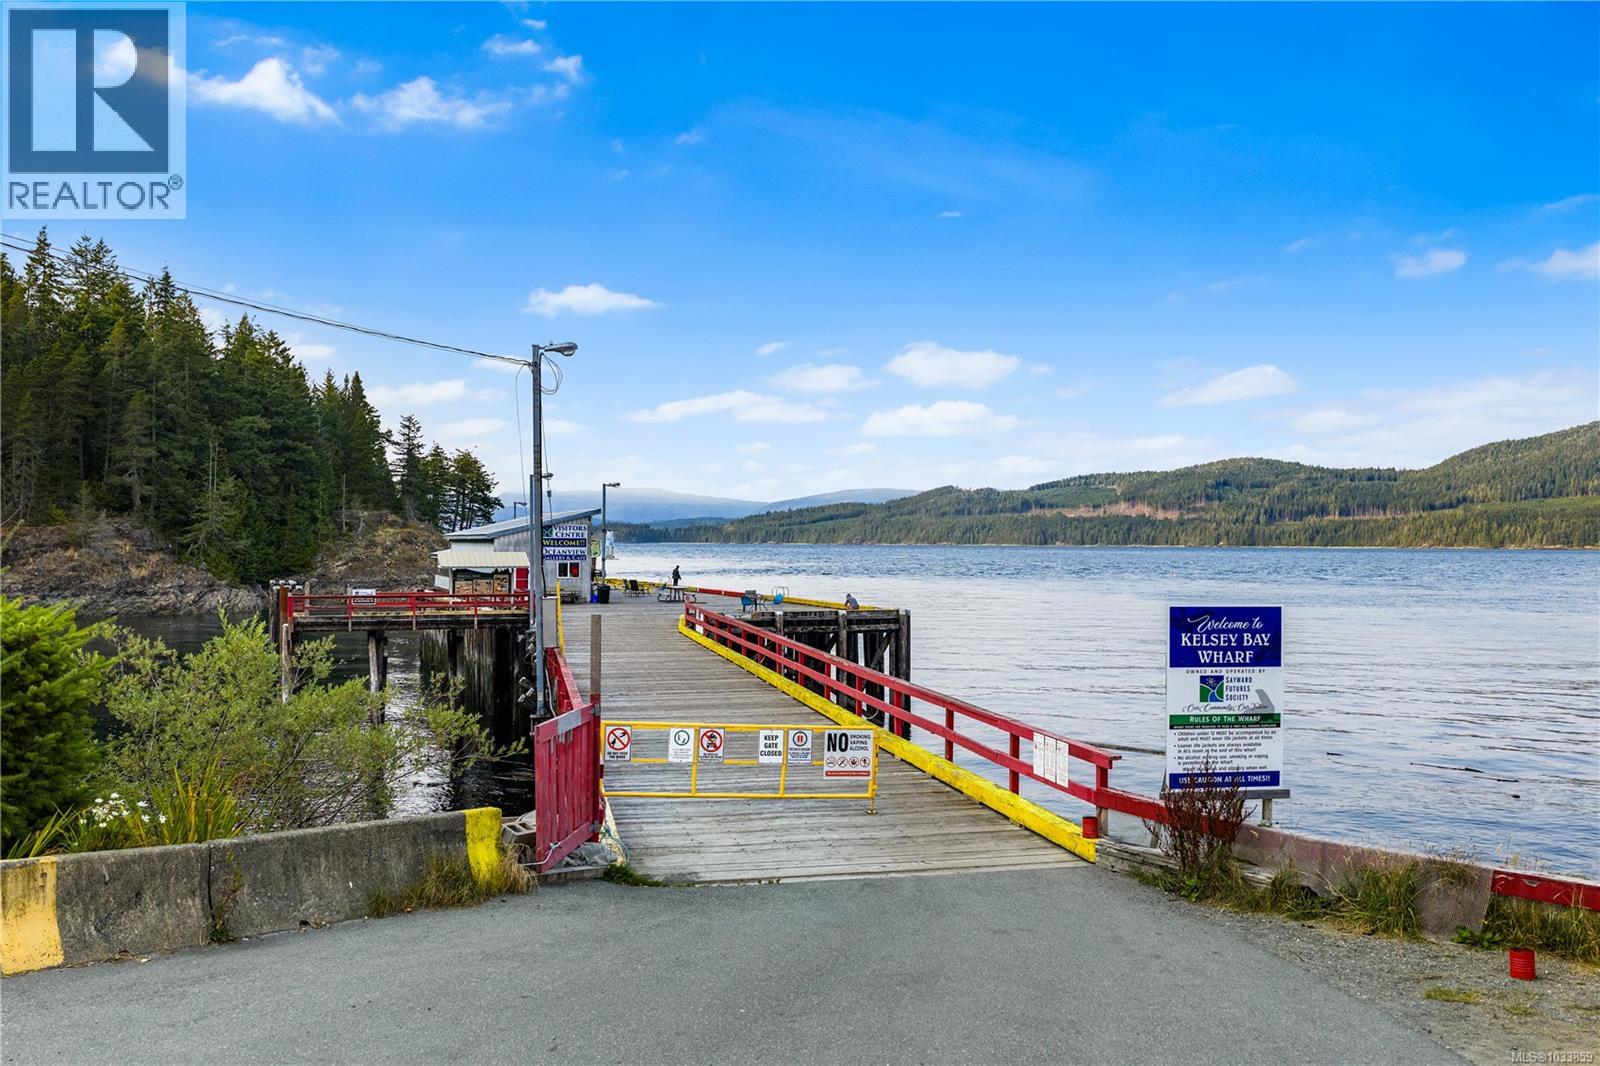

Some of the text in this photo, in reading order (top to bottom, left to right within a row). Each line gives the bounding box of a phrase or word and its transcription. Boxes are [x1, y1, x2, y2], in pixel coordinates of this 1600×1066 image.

[1187, 614, 1264, 633] Welcome to
[1181, 632, 1270, 647] KELSEY BAY
[1198, 650, 1254, 664] WHARF
[827, 732, 849, 752] NO
